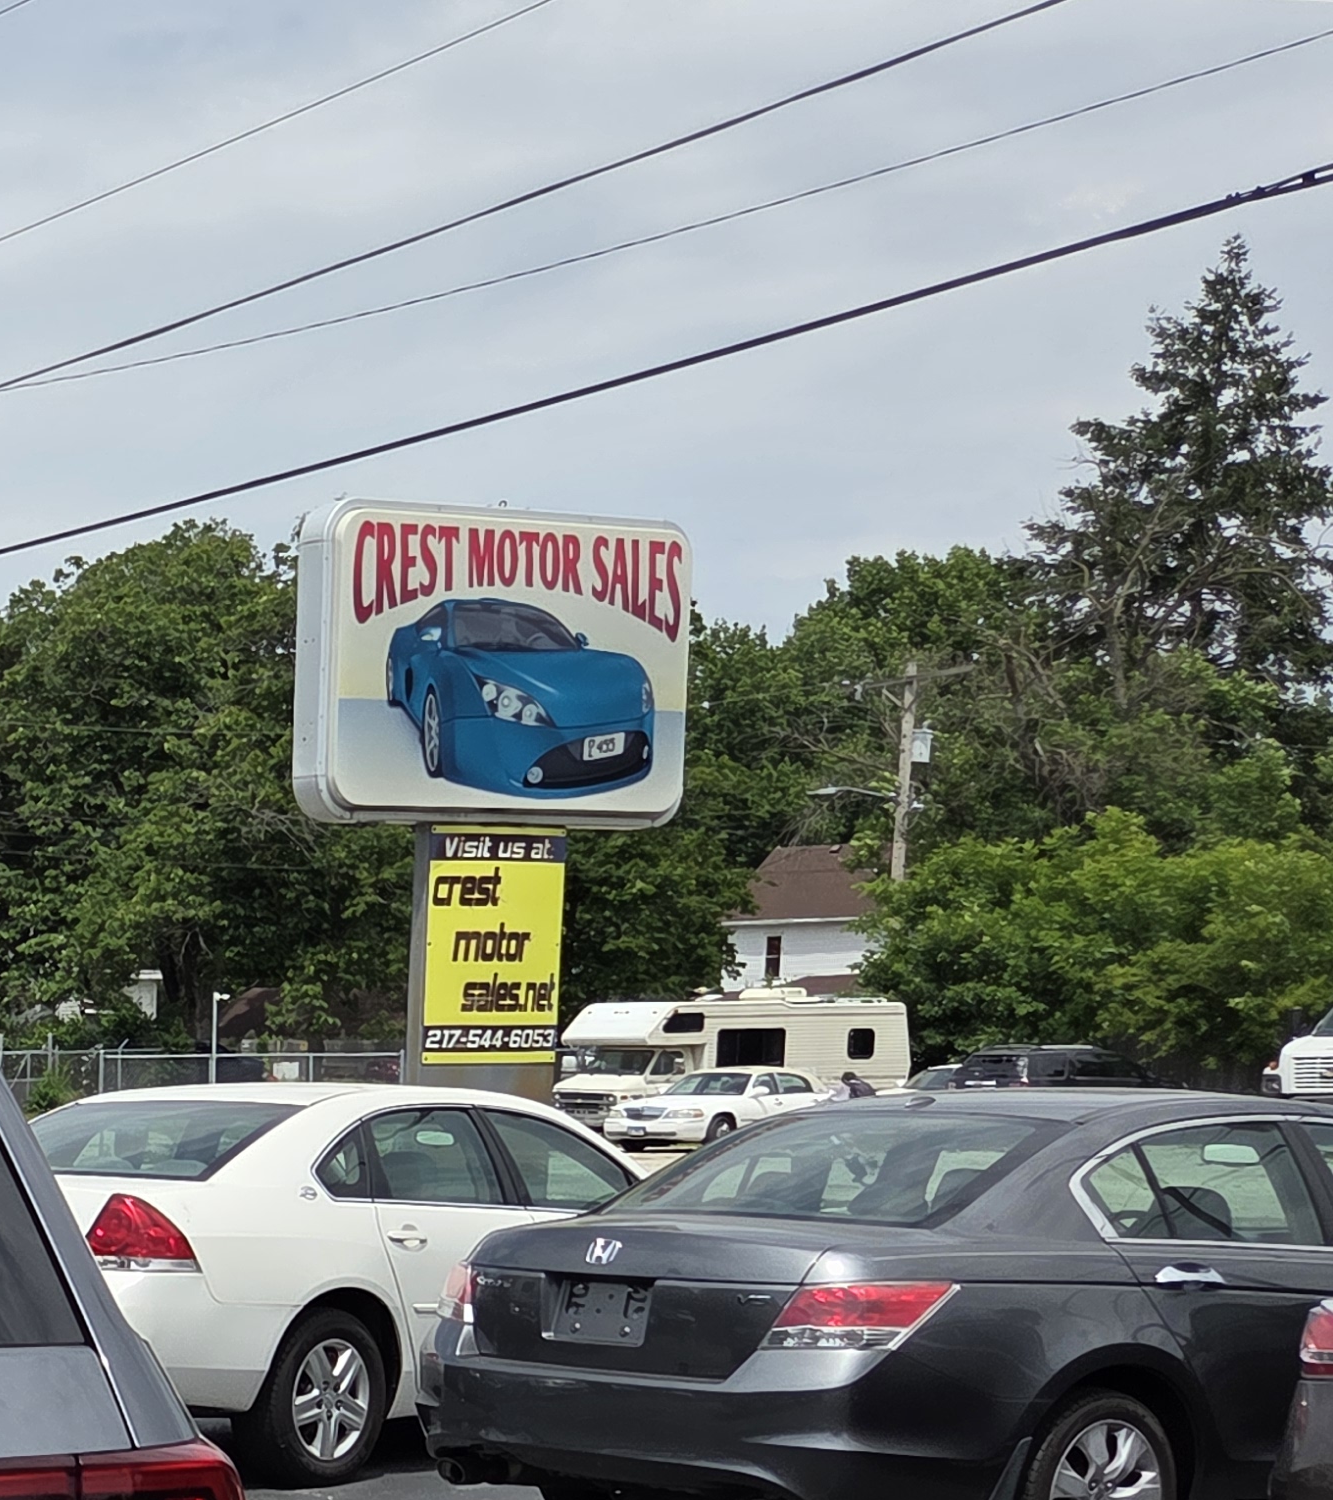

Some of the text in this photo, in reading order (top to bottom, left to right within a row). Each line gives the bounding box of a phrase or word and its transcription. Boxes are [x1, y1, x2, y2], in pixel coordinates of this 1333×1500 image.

[353, 520, 683, 643] CREST MOTOR SALES
[445, 836, 492, 858] Visit
[498, 842, 526, 858] us
[432, 866, 501, 907] crest
[451, 922, 531, 962] motor
[460, 972, 555, 1013] sales.net
[425, 1029, 555, 1049] 217-544-6053
